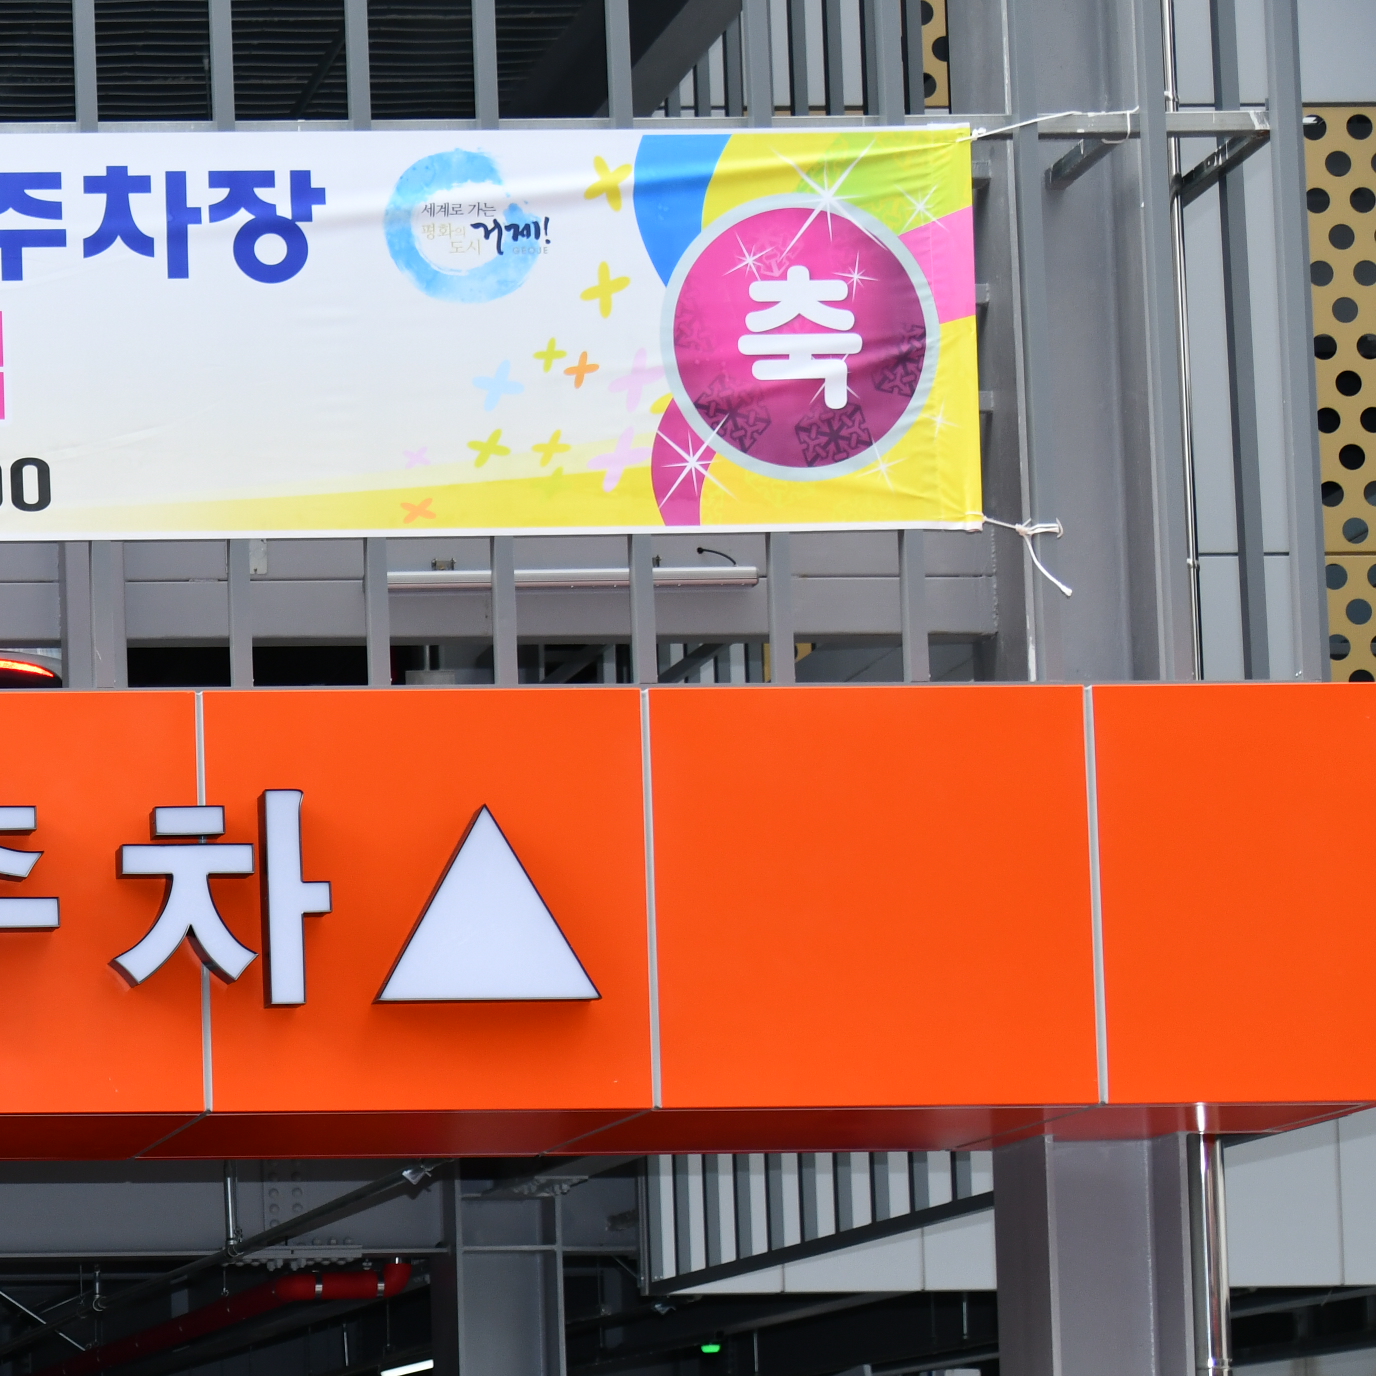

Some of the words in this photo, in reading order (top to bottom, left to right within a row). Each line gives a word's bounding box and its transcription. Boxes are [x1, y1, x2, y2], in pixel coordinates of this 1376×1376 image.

[421, 202, 465, 217] 세계로
[467, 202, 497, 217] 가는
[449, 239, 482, 255] 도시
[737, 264, 863, 410] 축
